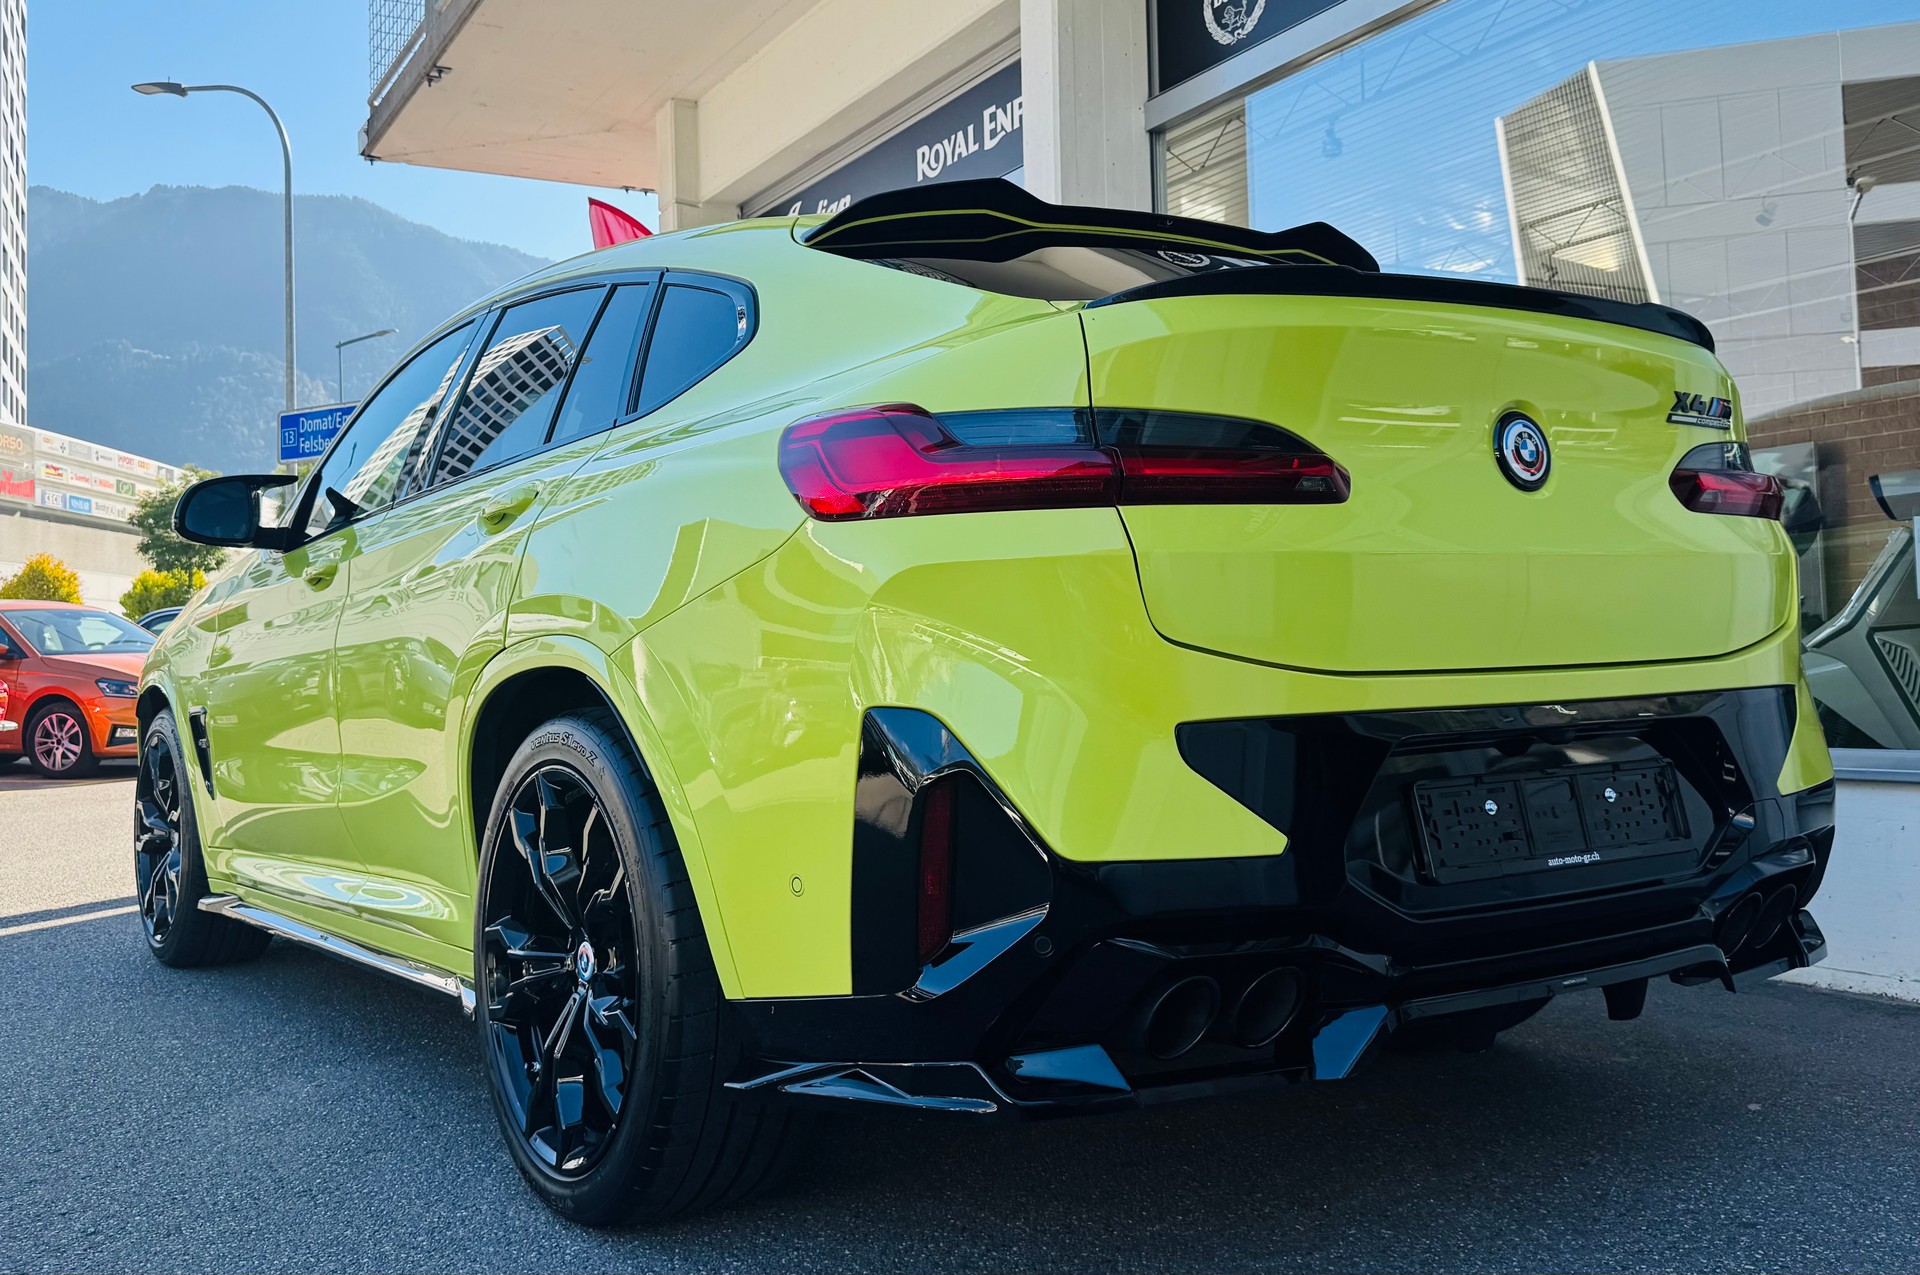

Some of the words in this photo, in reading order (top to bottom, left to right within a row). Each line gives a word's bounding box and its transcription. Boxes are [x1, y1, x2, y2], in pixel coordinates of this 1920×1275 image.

[916, 123, 979, 182] ROYAL
[284, 431, 294, 444] 13
[300, 434, 333, 454] Felsbe
[1548, 851, 1600, 866] auto-moto-gr.ch
